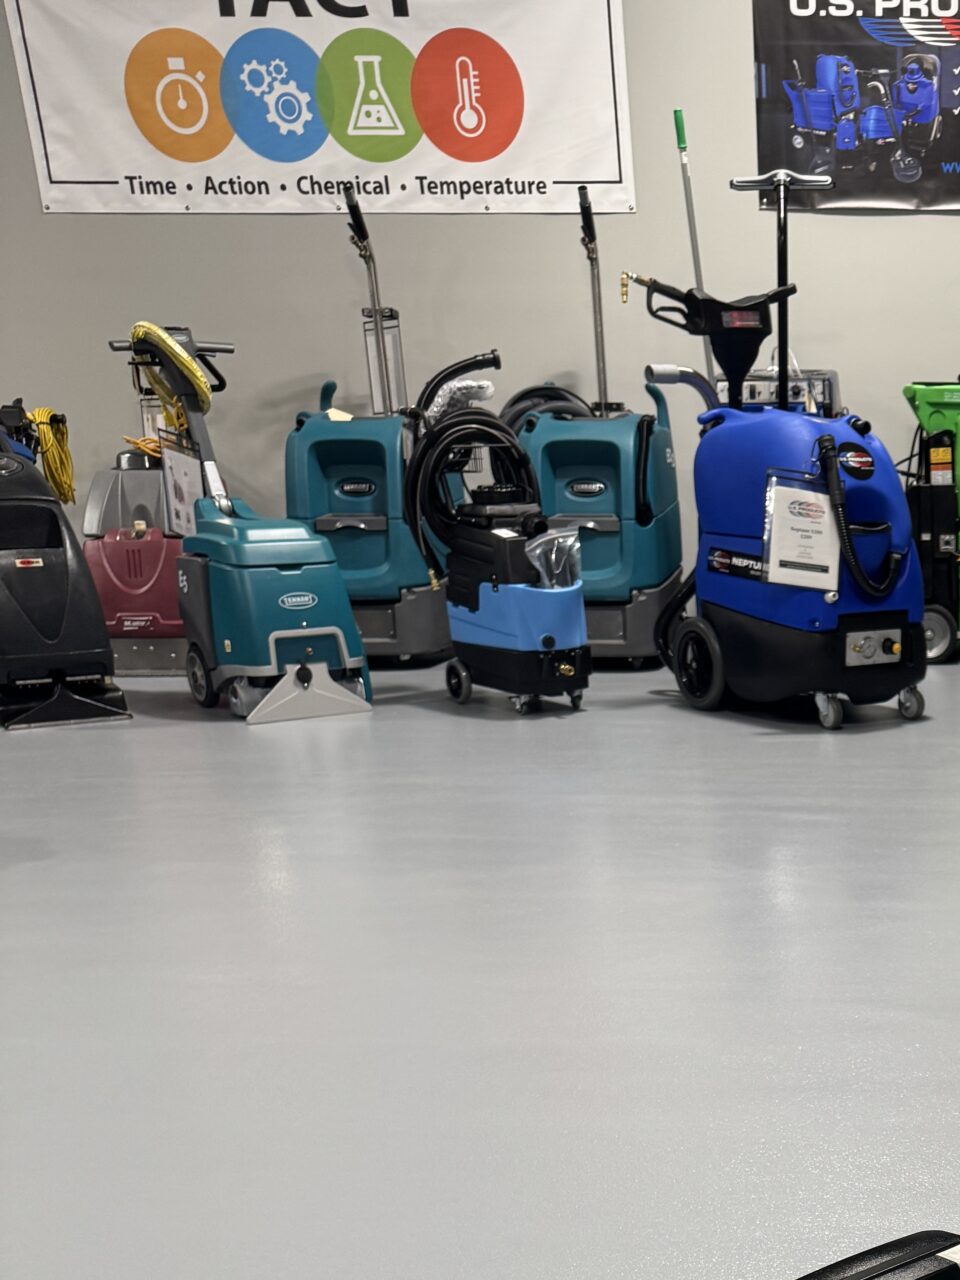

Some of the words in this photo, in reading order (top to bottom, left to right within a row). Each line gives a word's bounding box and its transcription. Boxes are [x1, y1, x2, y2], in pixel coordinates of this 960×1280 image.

[124, 175, 177, 195] Time
[204, 175, 271, 195] Action
[296, 175, 391, 195] Chemical
[414, 176, 548, 200] Temperature
